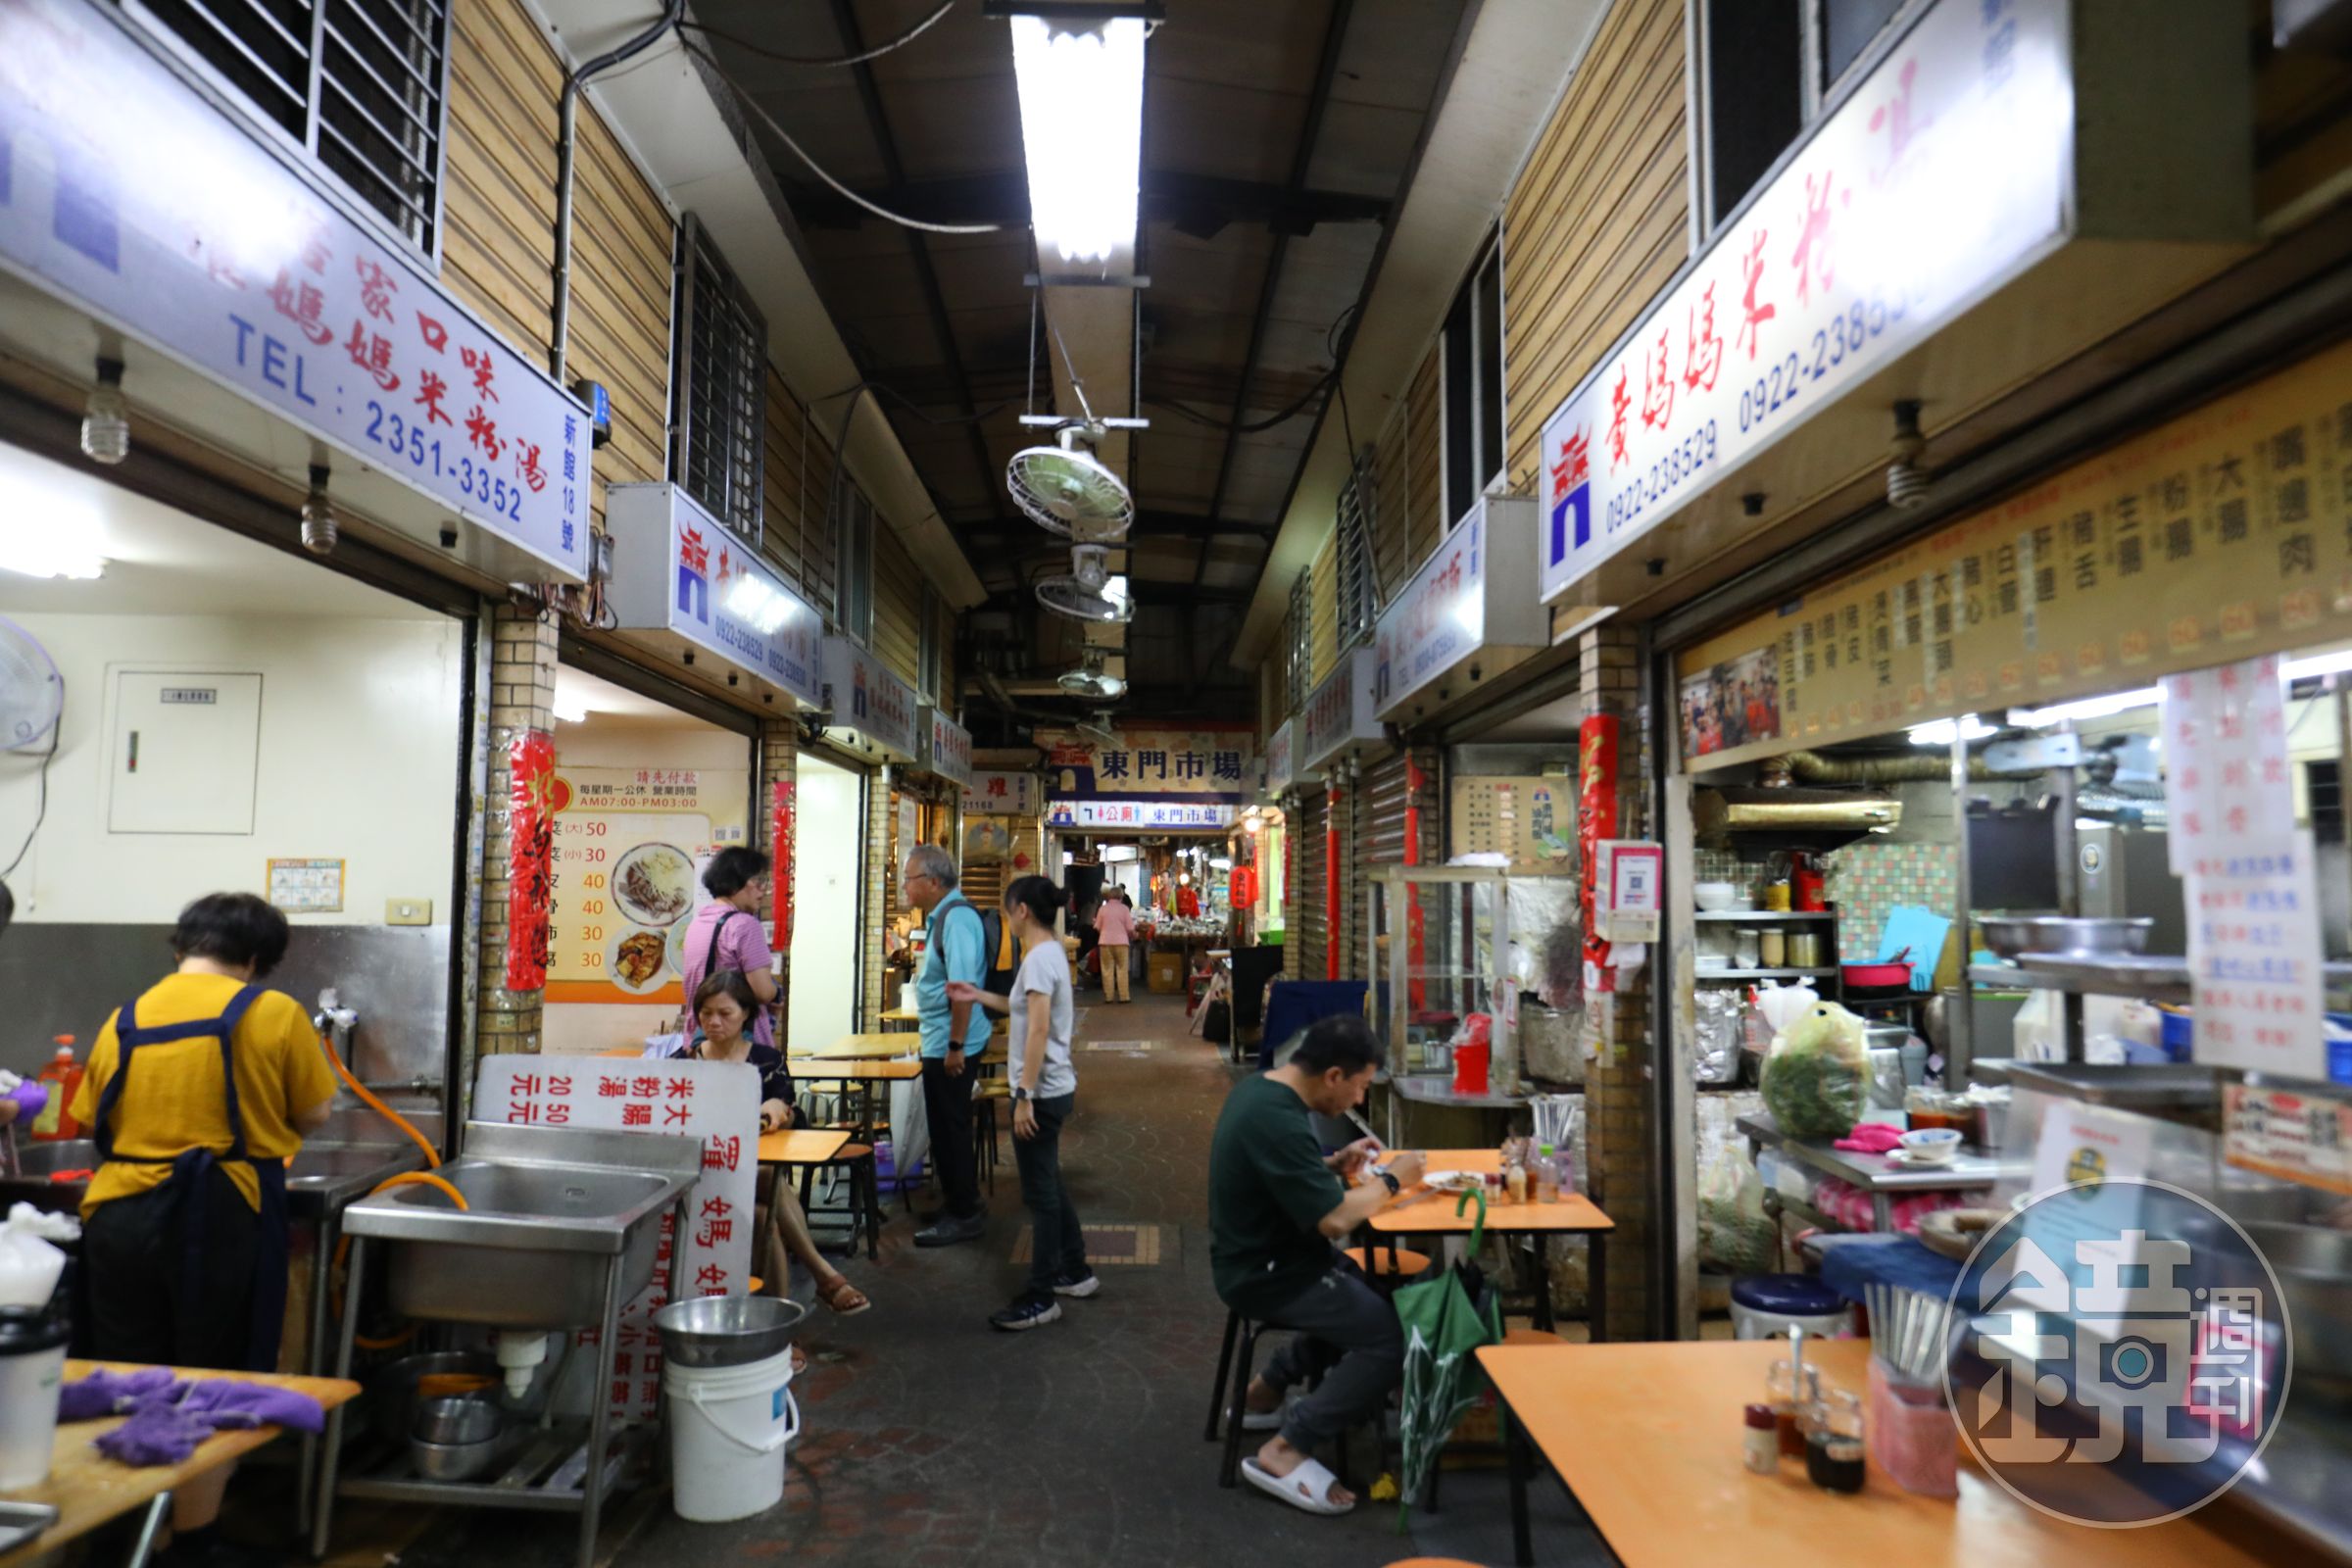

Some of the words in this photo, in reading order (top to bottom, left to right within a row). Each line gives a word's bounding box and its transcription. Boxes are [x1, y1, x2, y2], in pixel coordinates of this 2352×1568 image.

[201, 220, 548, 492] 媽媽米粉湯
[366, 400, 521, 522] 2351-3352
[1606, 418, 1716, 534] 0922-238529
[1101, 751, 1241, 780] 東門市場
[636, 771, 697, 784] 請先付款
[579, 785, 647, 795] 每星期一公休
[653, 786, 697, 796] 營業時間
[580, 797, 697, 808] AM07:00-PM03:00
[1152, 808, 1217, 823] 東門市場
[586, 822, 607, 836] 50
[585, 848, 606, 862] 30
[583, 874, 605, 889] 40
[582, 901, 604, 914] 40
[581, 927, 603, 941] 30
[580, 953, 602, 967] 30
[599, 1075, 695, 1100] 米粉湯
